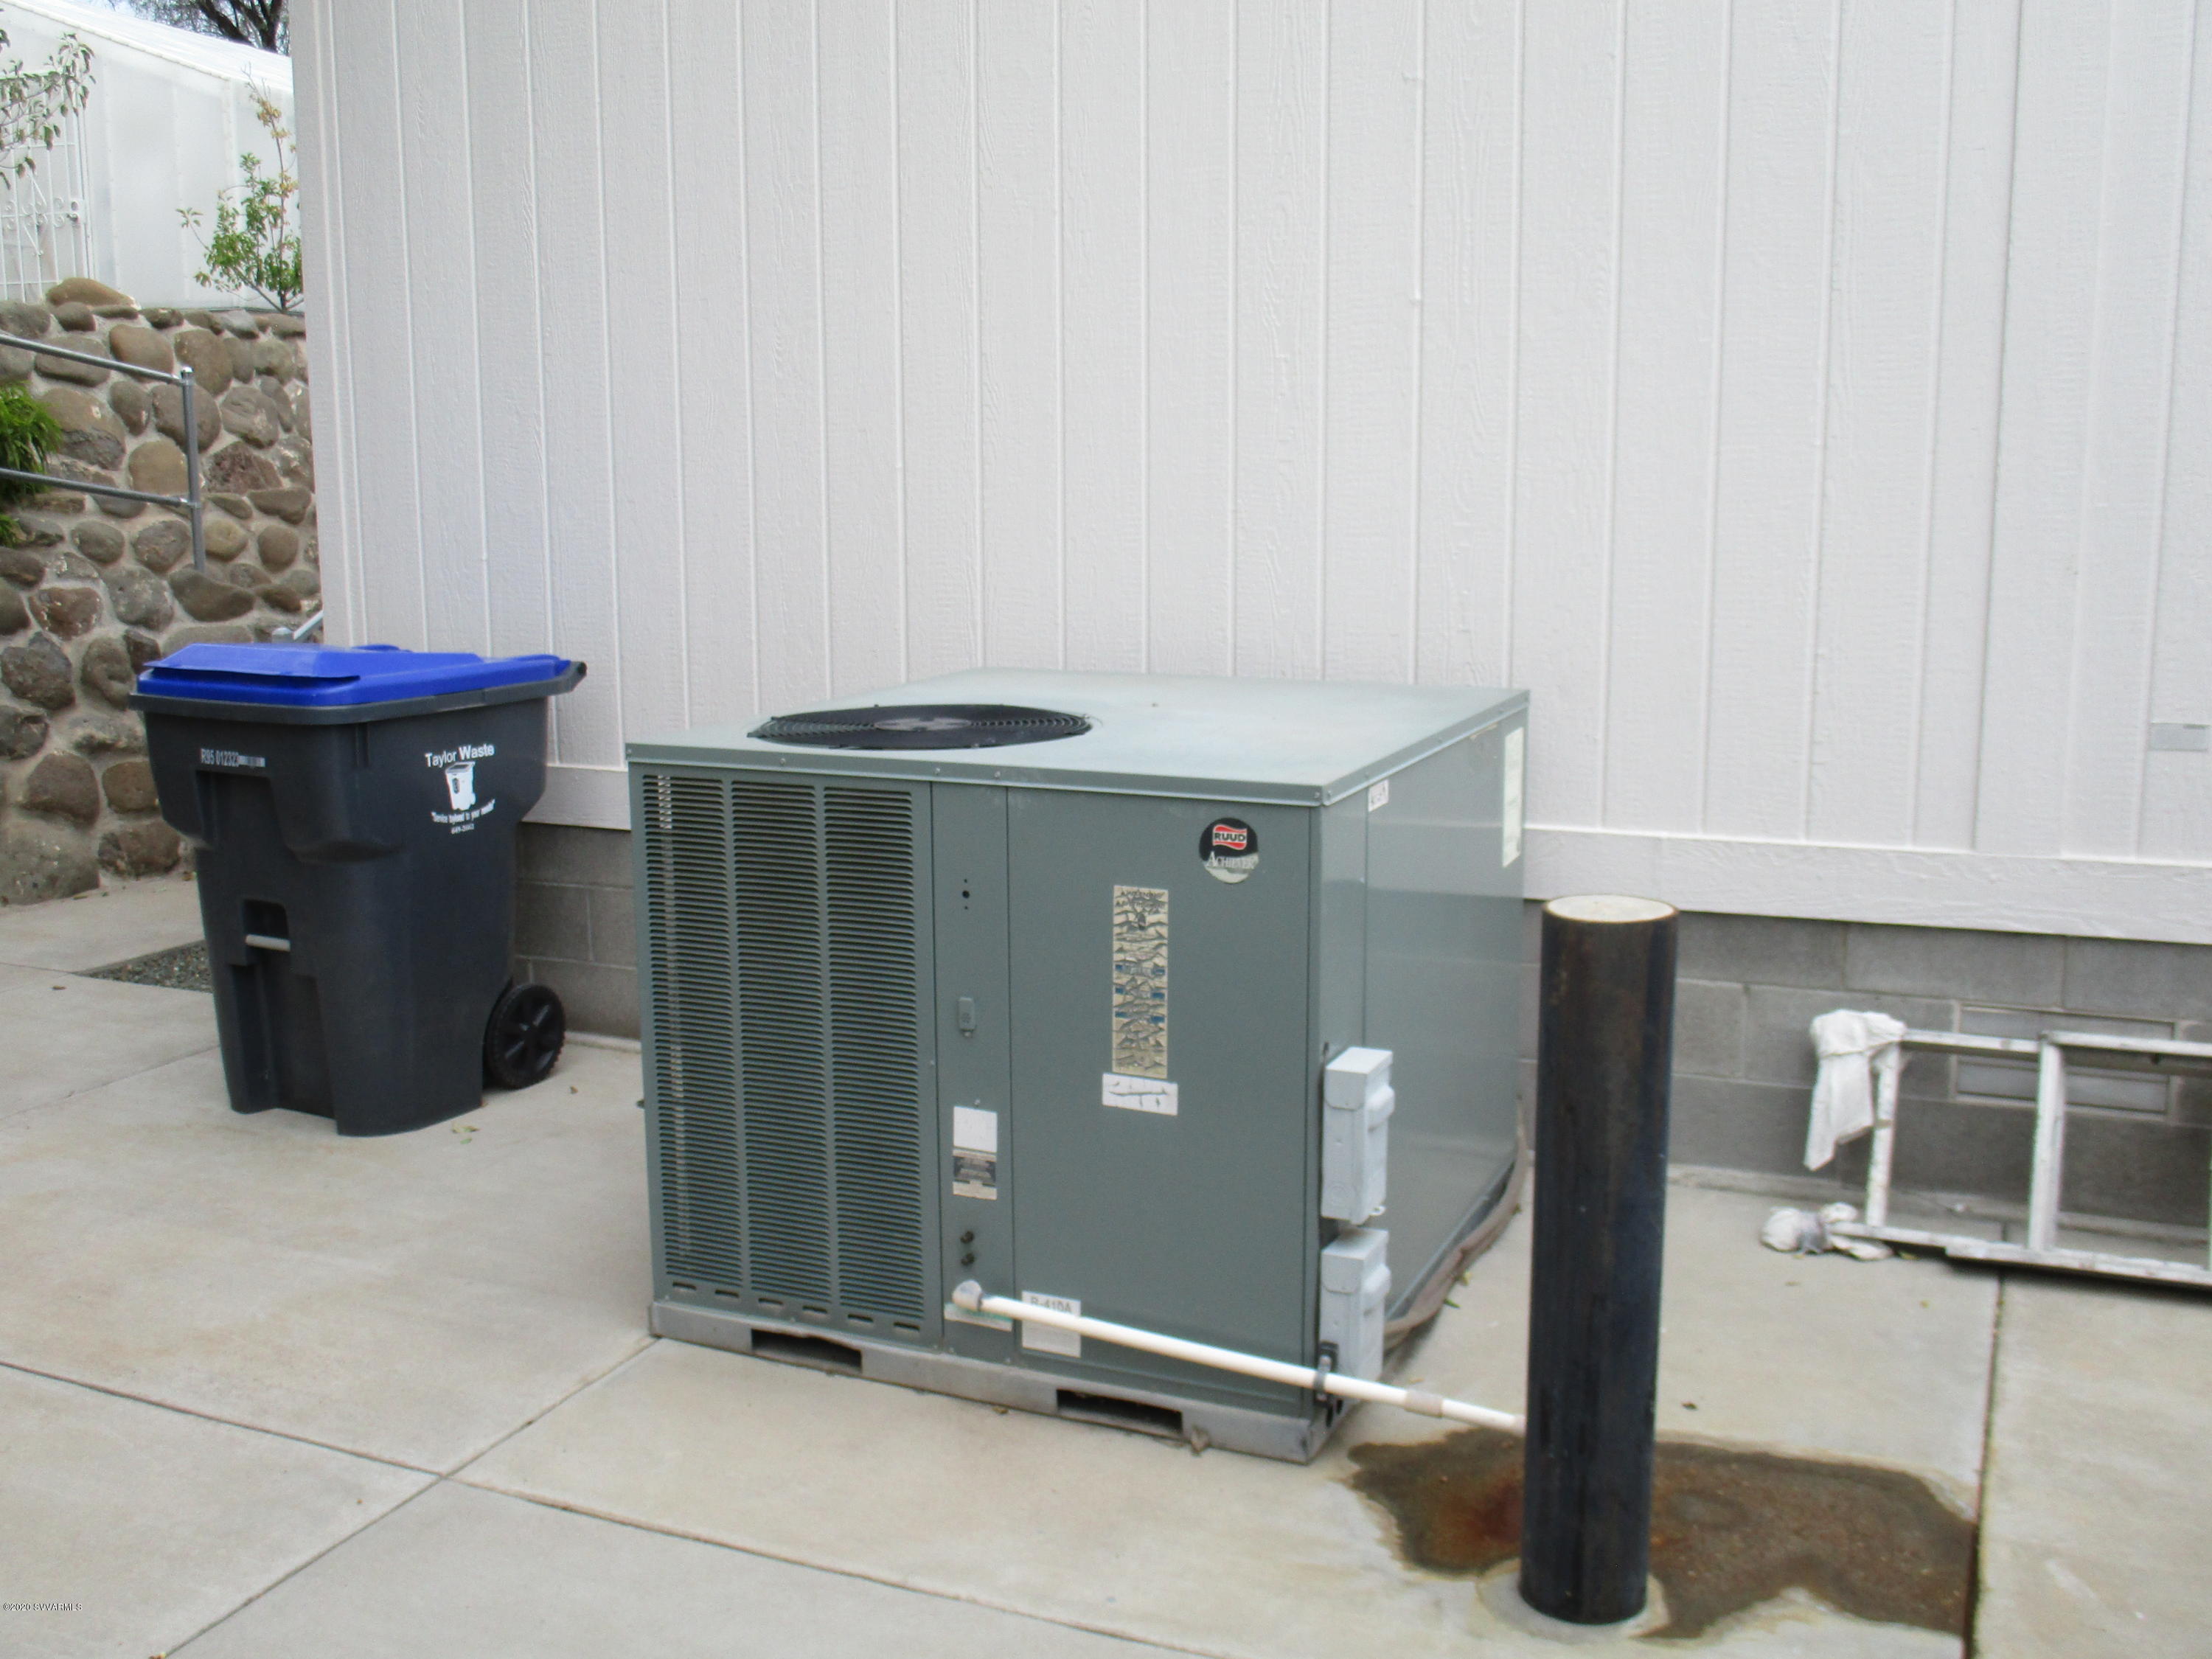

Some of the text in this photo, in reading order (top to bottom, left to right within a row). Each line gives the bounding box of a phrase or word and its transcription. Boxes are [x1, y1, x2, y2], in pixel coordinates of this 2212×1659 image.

[425, 743, 495, 768] Taylor Waste
[1214, 832, 1246, 842] RUUD
